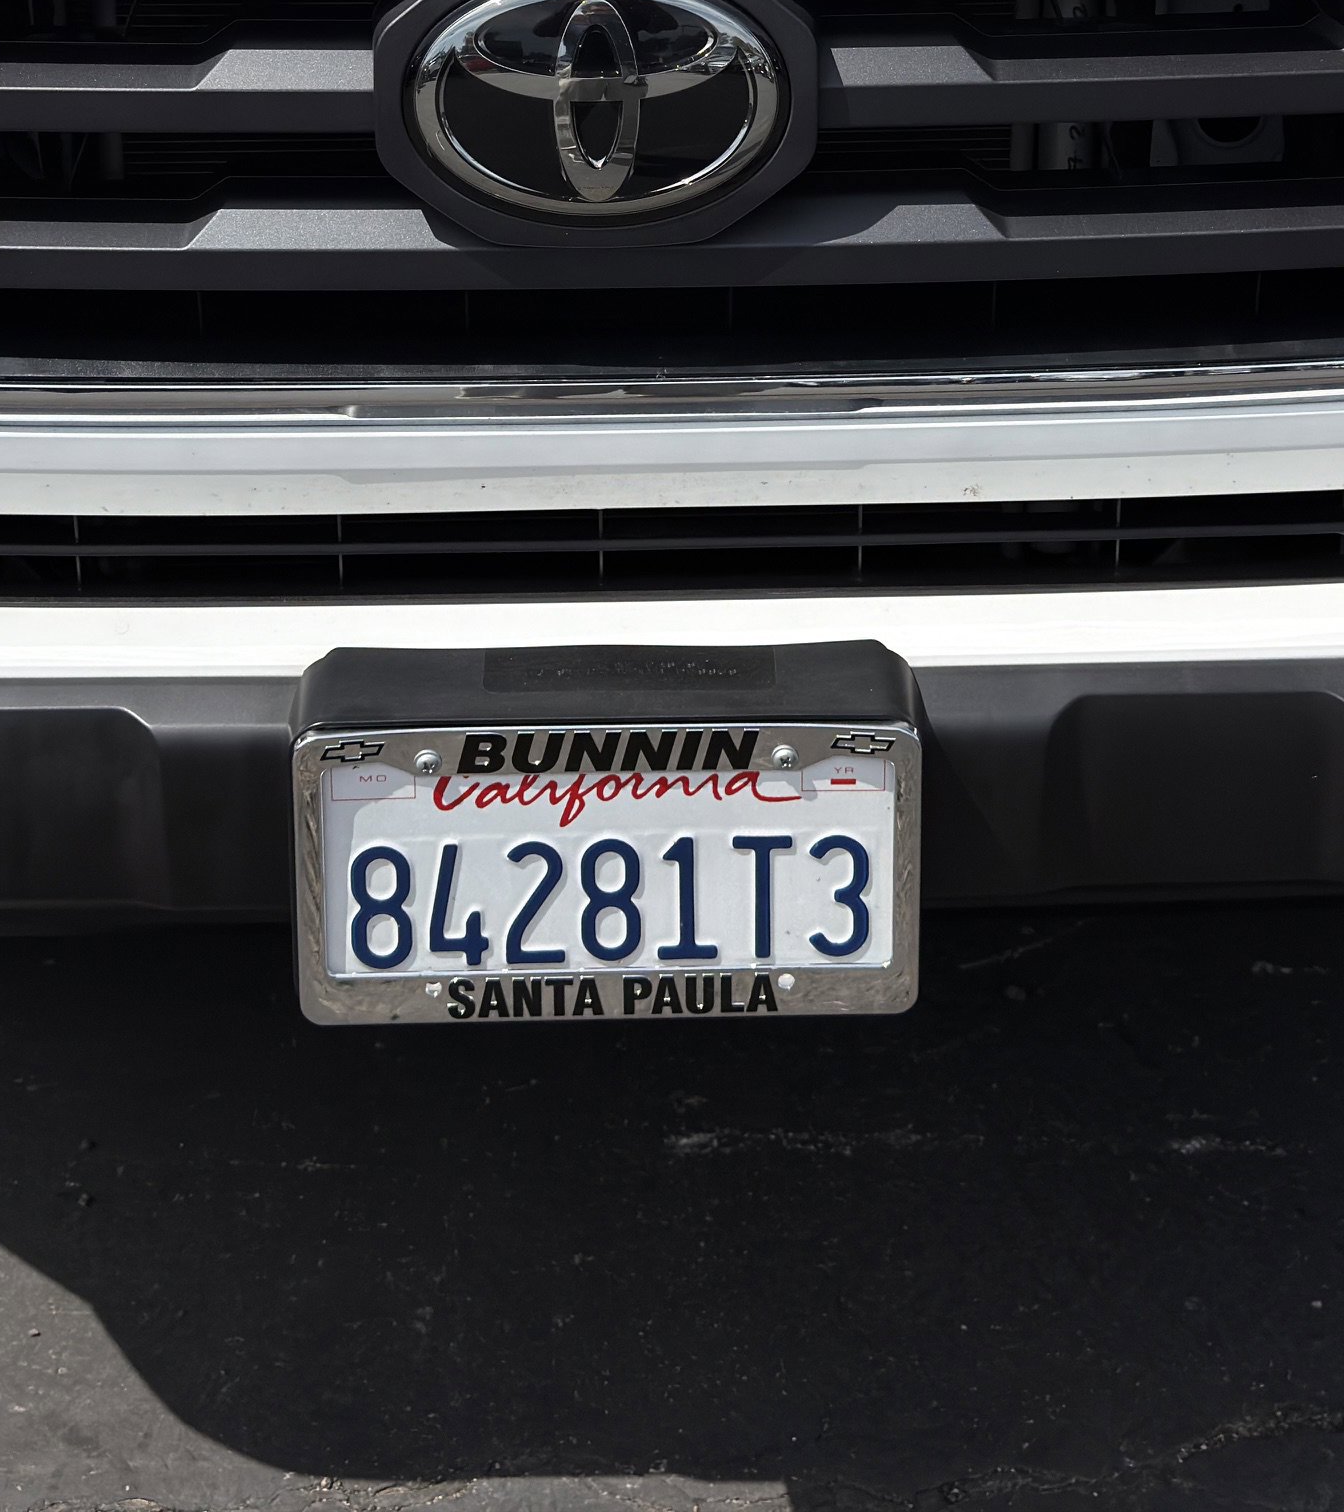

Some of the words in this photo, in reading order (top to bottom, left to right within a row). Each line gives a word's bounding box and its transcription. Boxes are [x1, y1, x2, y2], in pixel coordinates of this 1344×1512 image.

[456, 728, 760, 775] BUNNIN
[834, 766, 855, 774] YR
[359, 775, 388, 783] MO
[432, 770, 802, 827] California
[350, 834, 870, 970] 84281T3
[447, 976, 604, 1020] SANTA
[623, 974, 778, 1016] PAULA
